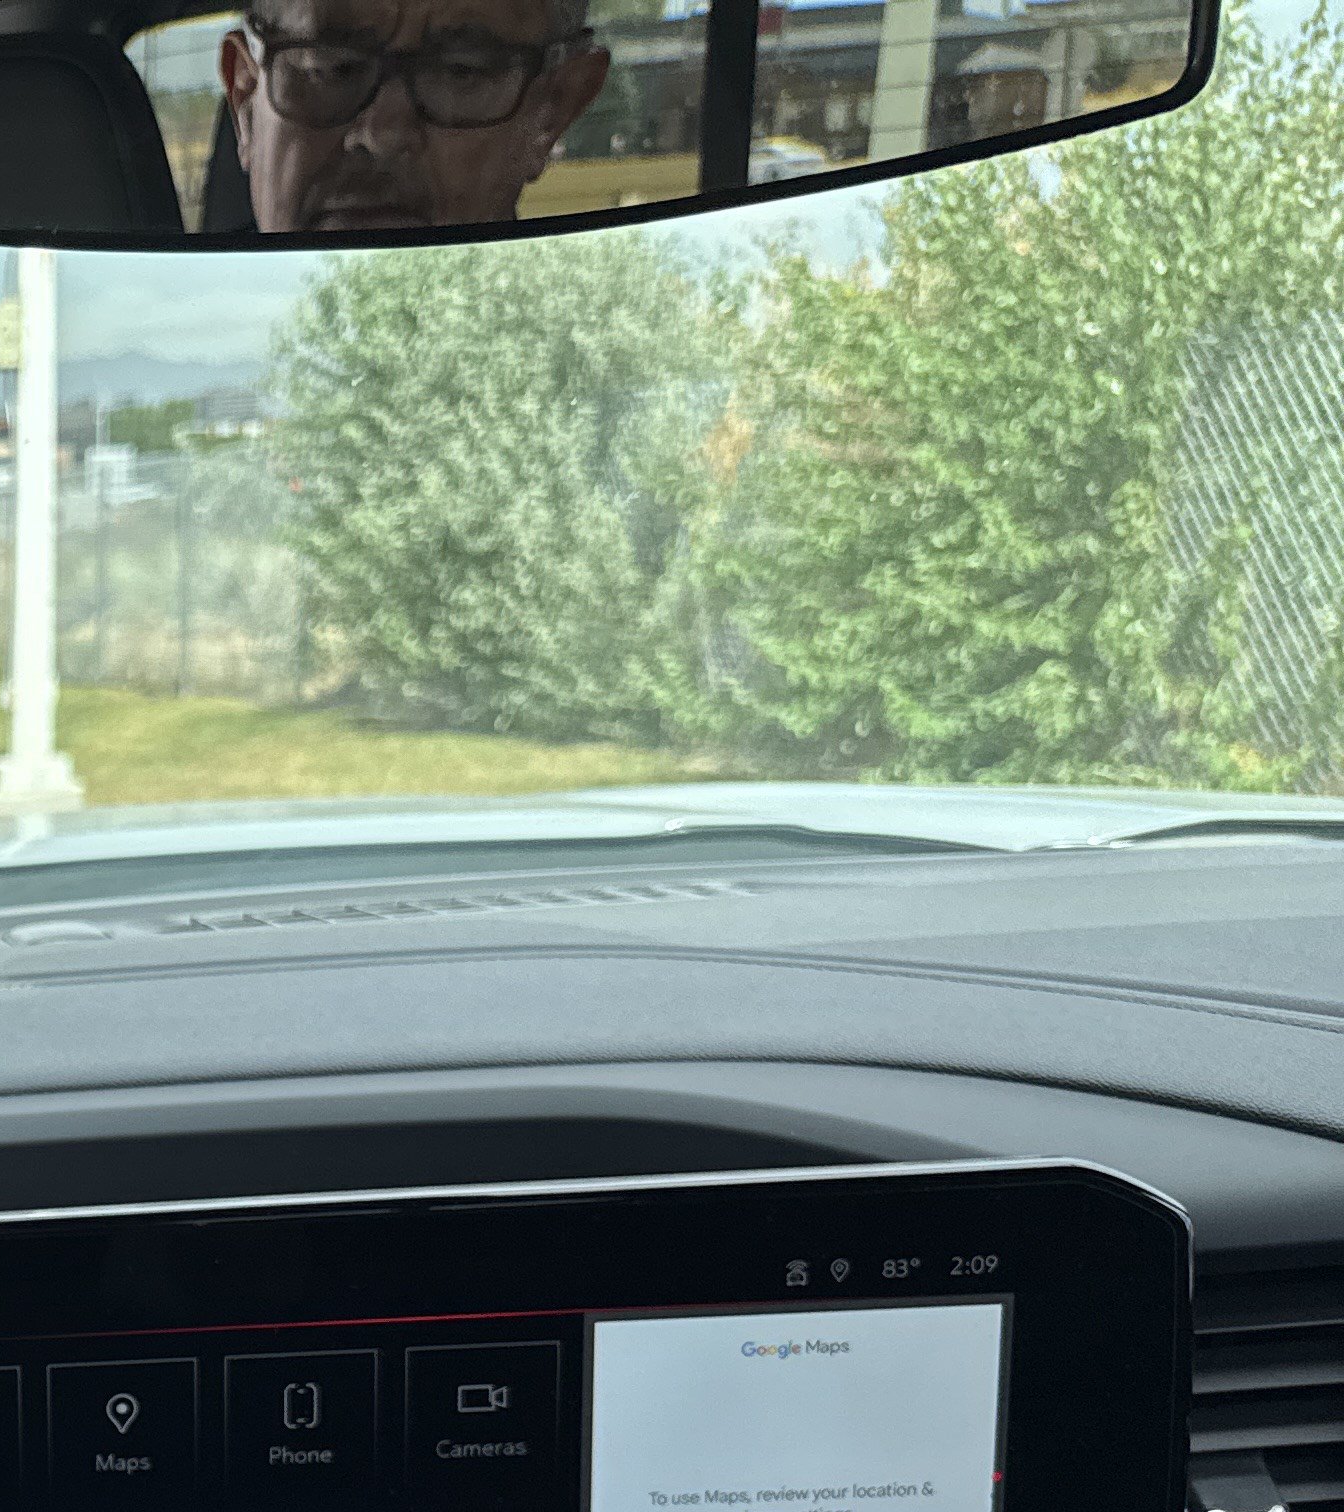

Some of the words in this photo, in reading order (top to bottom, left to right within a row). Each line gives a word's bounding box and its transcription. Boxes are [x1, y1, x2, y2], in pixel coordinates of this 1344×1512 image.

[950, 1255, 998, 1276] 2:09
[741, 1340, 801, 1359] Google
[806, 1338, 850, 1359] Maps
[269, 1445, 333, 1465] Phone
[435, 1438, 527, 1459] Cameras
[95, 1454, 151, 1475] Maps
[648, 1490, 668, 1507] To
[669, 1493, 701, 1507] use
[704, 1488, 751, 1508] Maps,
[755, 1486, 808, 1502] review
[813, 1485, 848, 1504] your
[853, 1482, 916, 1500] location
[921, 1482, 934, 1497] &
